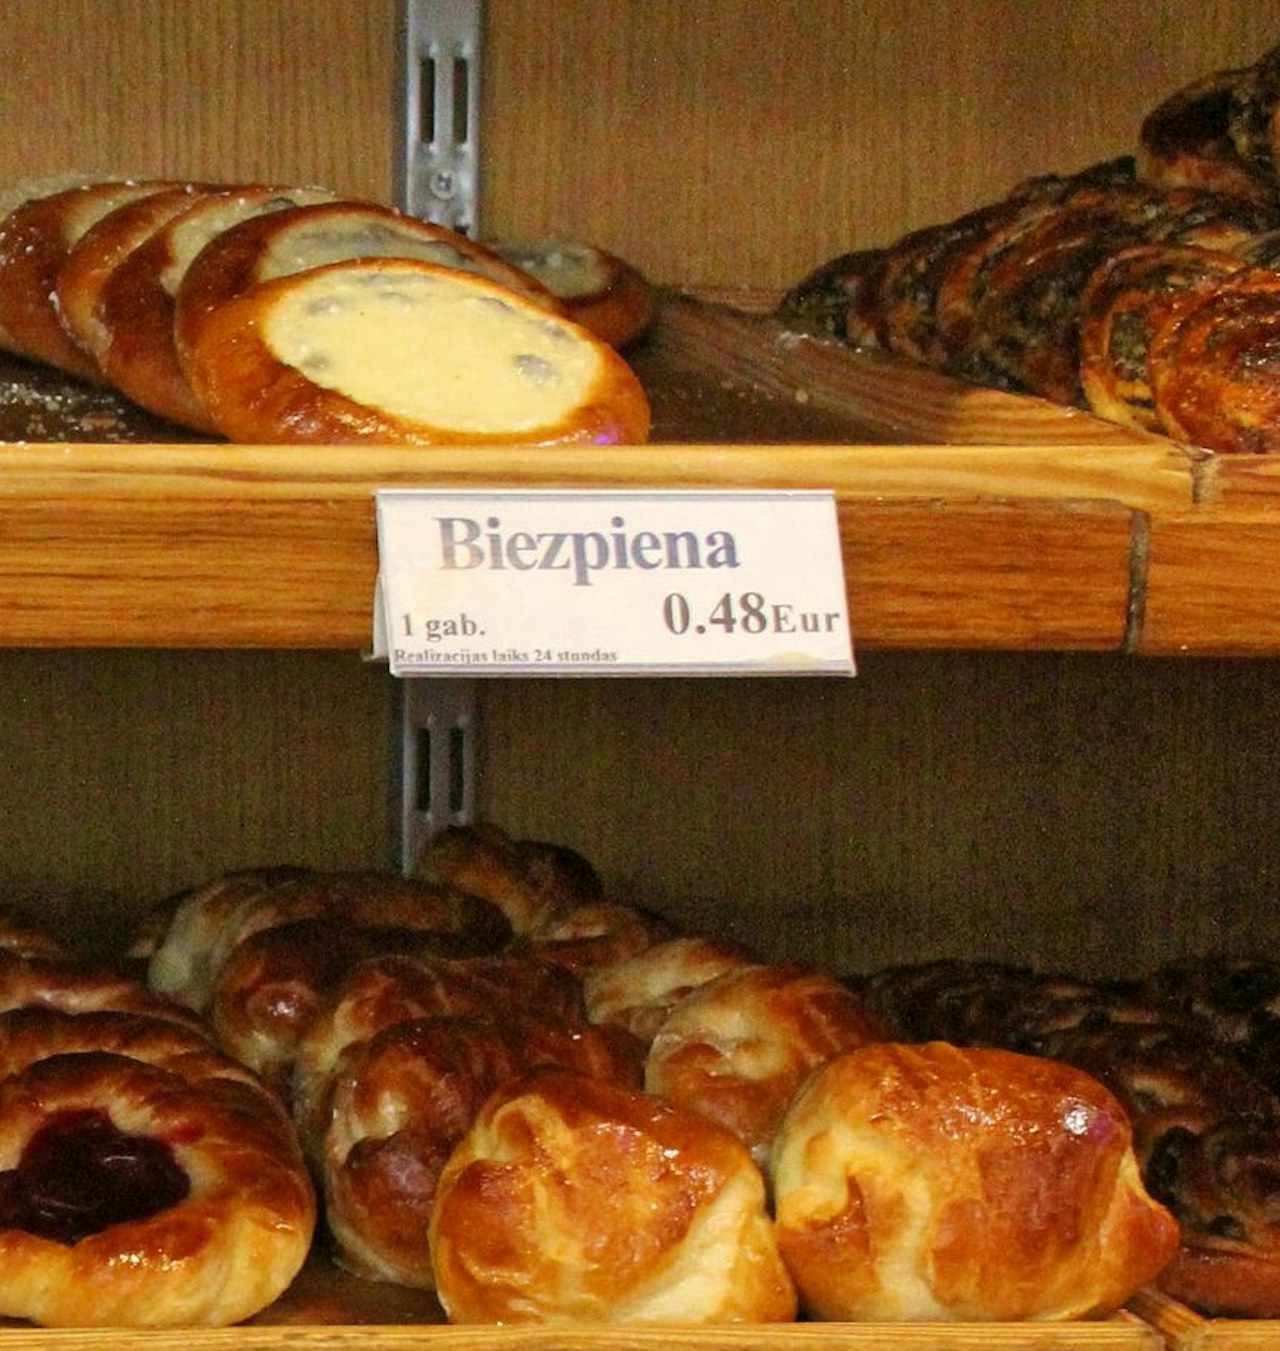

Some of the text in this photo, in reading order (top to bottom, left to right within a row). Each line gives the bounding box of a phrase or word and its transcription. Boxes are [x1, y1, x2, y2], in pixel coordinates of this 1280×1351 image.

[434, 516, 739, 587] Biezpiena
[401, 613, 486, 641] 1 gab.
[394, 649, 617, 665] Realizacijas laiks 24 stundas
